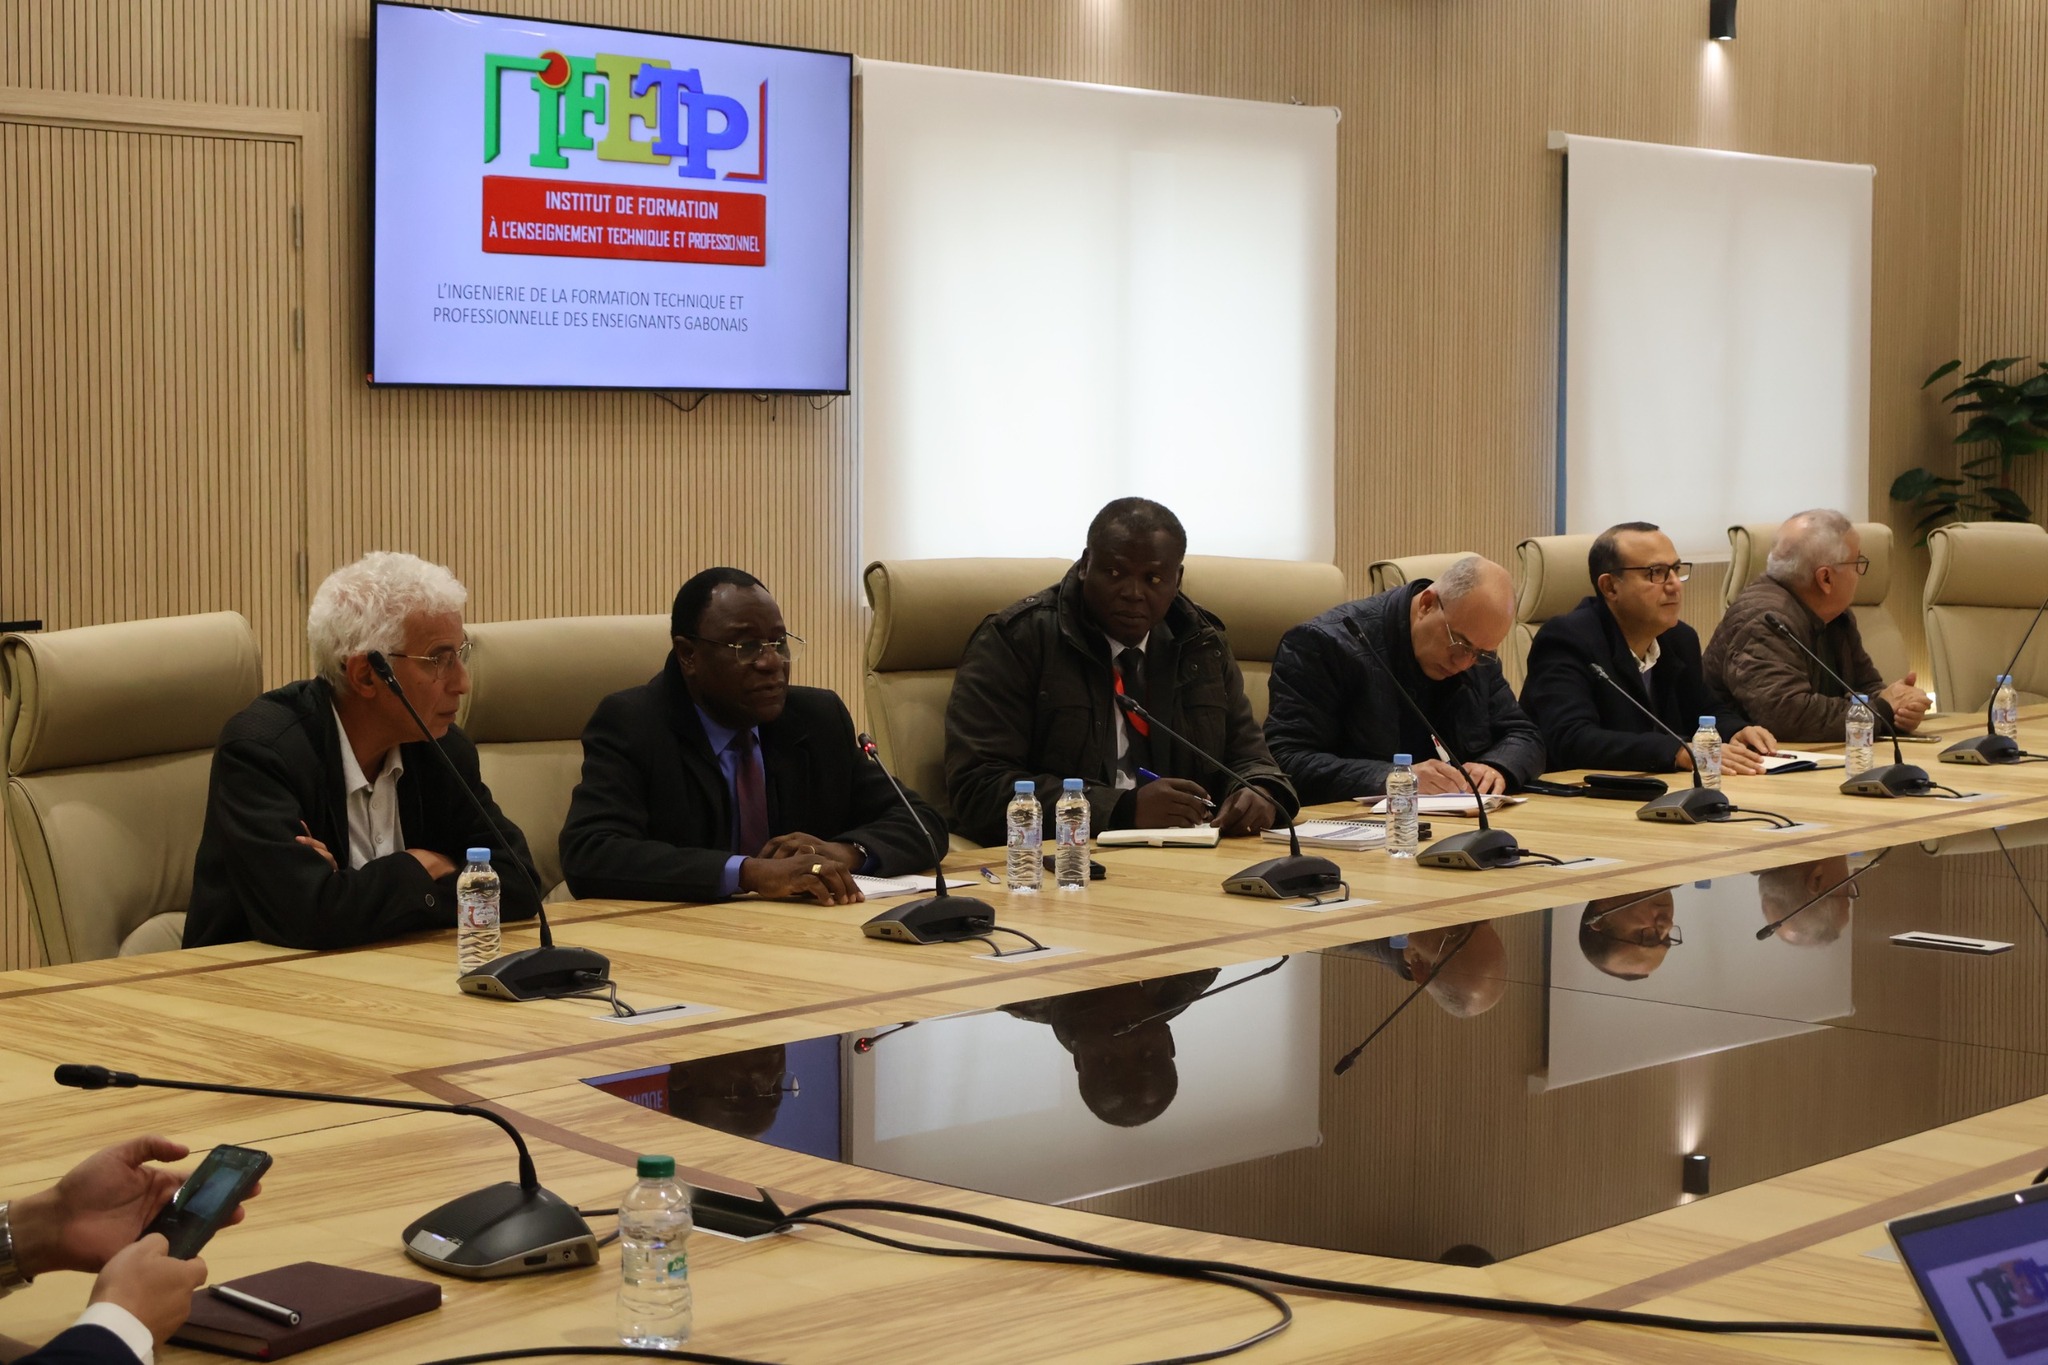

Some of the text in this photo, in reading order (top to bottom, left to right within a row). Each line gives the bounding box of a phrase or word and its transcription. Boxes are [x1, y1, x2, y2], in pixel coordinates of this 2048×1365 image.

[546, 190, 718, 220] INSTITUT DE FORMATION
[489, 215, 760, 253] À L'ENSEIGNEMENT TECHNIQUE ET PROFESSIONNEL
[530, 287, 548, 303] DE
[552, 288, 568, 304] LA
[572, 289, 650, 307] FORMATION
[654, 292, 726, 310] TECHNIQUE
[730, 295, 744, 310] ET
[433, 306, 749, 332] PROFESSIONNELLE DES ENSEIGNANTS GABONAIS
